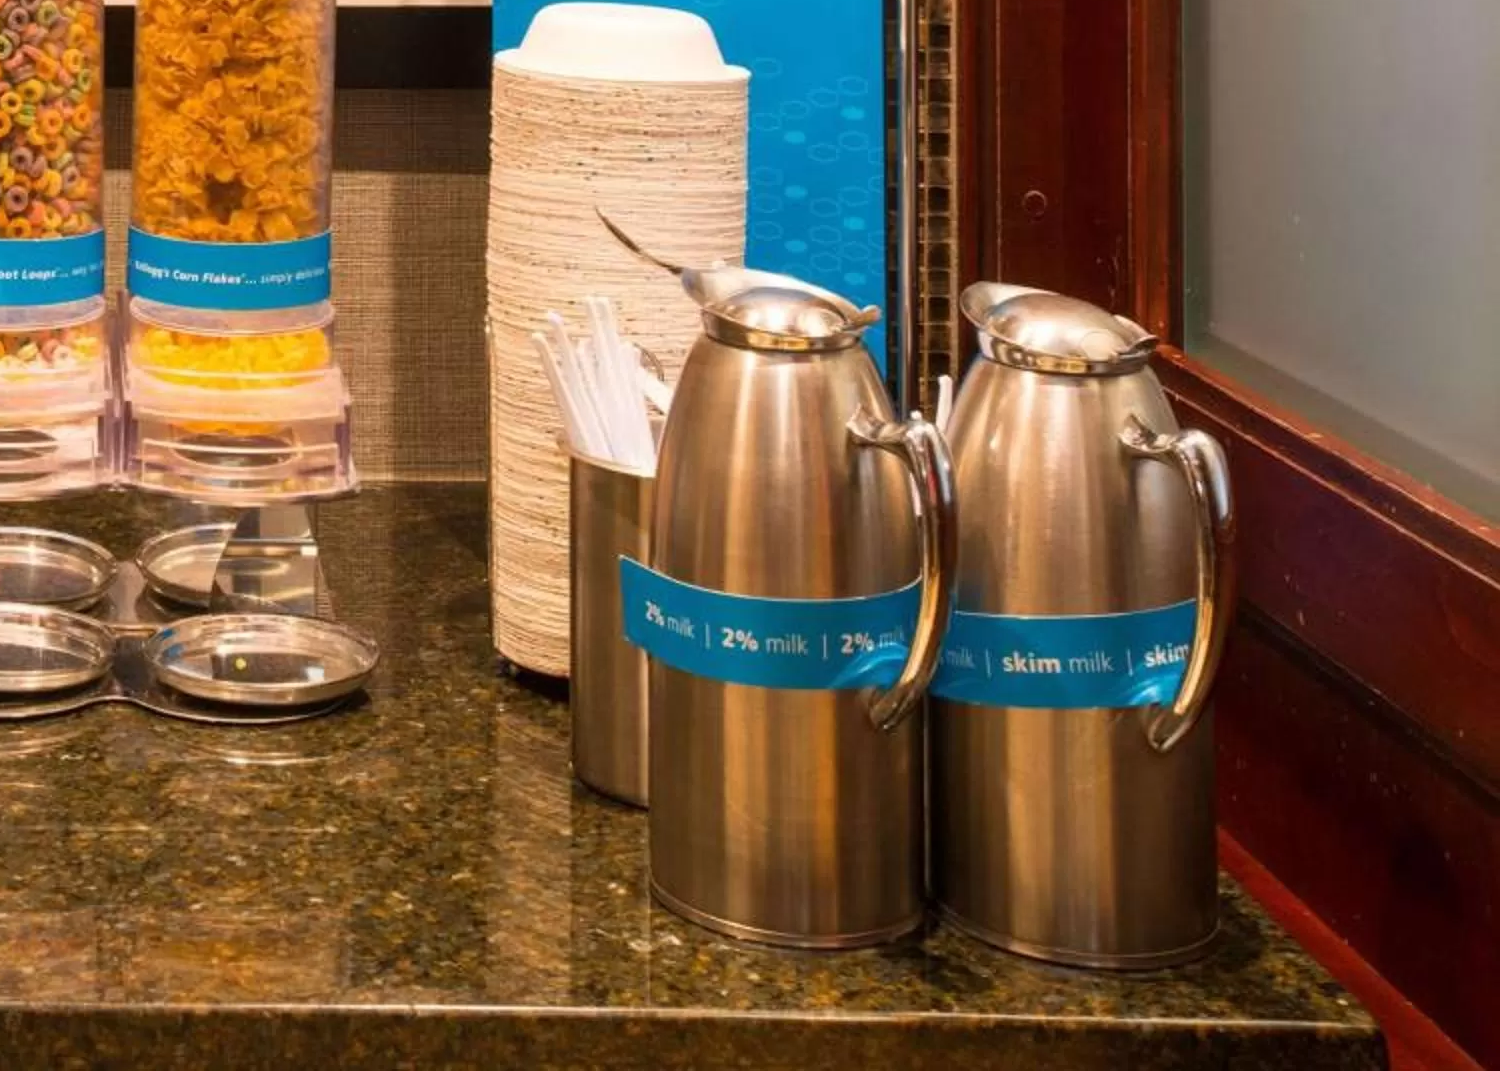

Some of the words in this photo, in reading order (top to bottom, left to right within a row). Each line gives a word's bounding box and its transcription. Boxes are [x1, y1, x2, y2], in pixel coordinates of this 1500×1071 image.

[172, 269, 199, 282] Corn
[645, 601, 664, 627] 2%
[667, 615, 695, 639] milk
[721, 627, 759, 652] 2%
[765, 633, 808, 656] milk
[840, 633, 875, 655] 2%
[1002, 650, 1062, 674] skim
[1068, 650, 1115, 672] milk
